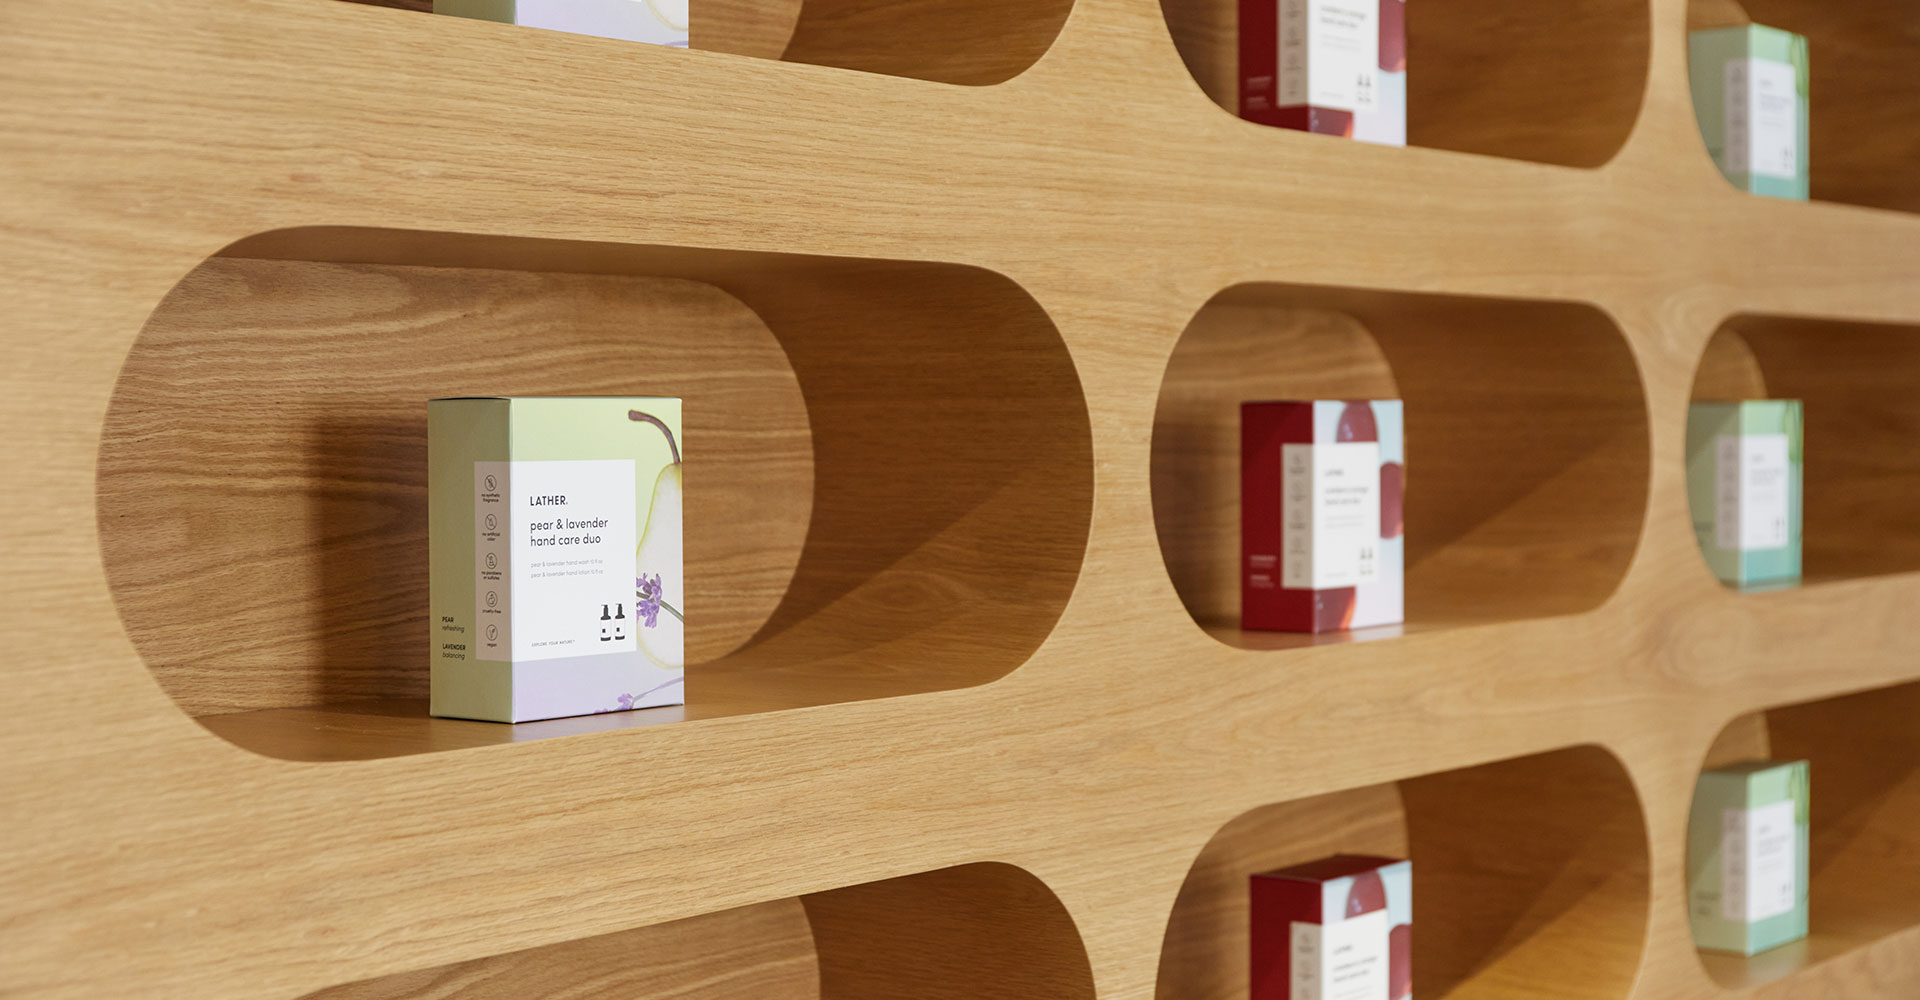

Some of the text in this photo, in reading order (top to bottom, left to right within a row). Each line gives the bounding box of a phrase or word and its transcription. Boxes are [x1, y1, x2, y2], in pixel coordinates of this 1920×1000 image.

[530, 517, 608, 534] pear & lavender
[530, 533, 601, 546] hand care duo
[442, 625, 464, 633] refreshing
[442, 652, 465, 660] balancing
